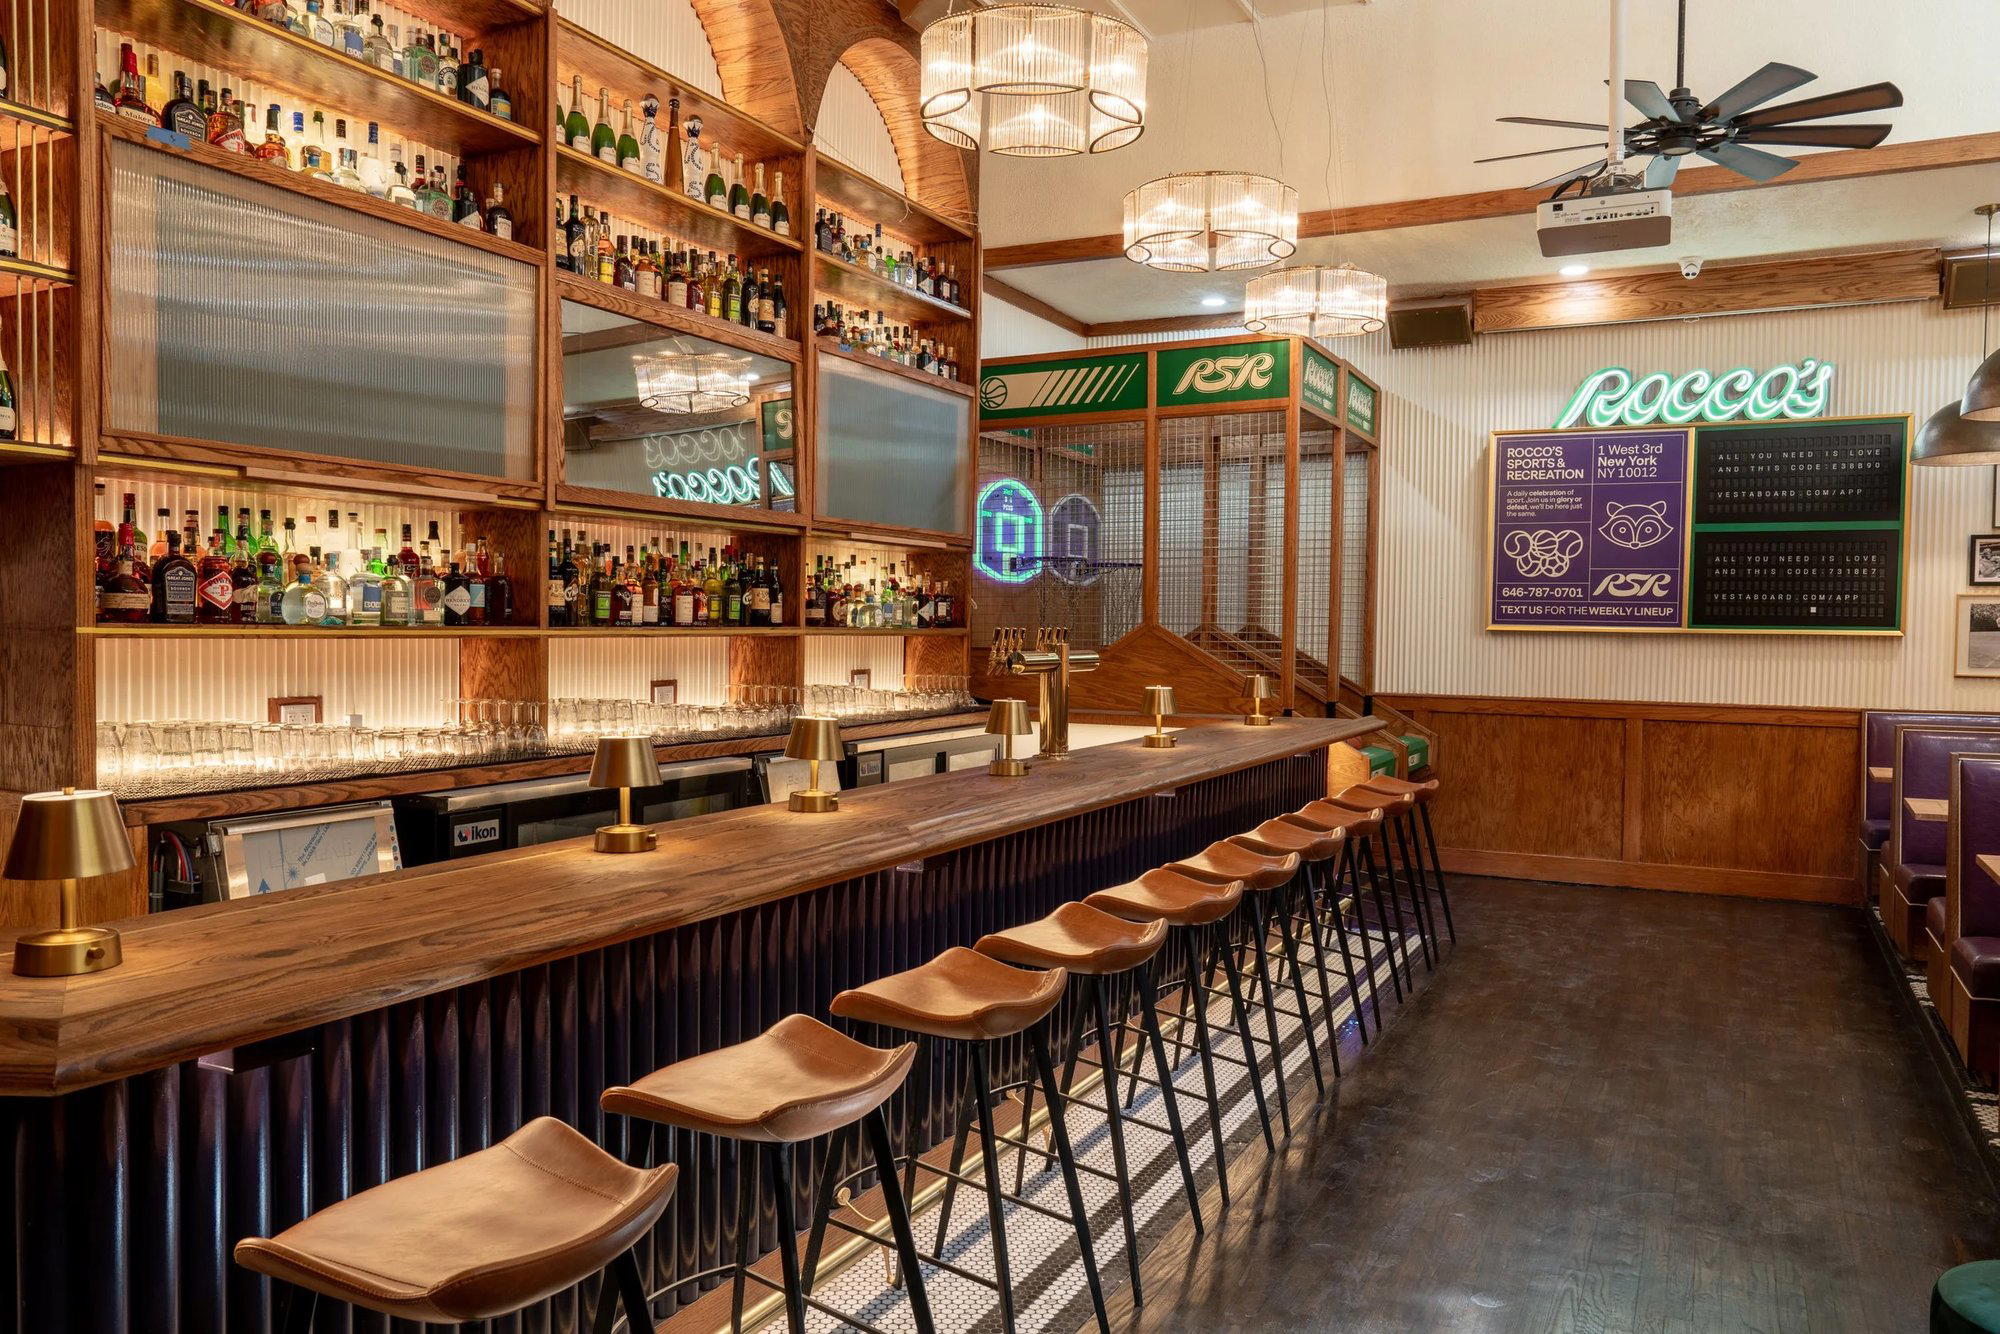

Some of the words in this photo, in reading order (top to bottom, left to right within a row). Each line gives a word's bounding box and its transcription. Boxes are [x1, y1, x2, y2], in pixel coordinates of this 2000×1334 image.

[95, 100, 113, 111] udson
[1507, 446, 1563, 458] ROCCO'S
[1598, 445, 1605, 456] 1
[1608, 444, 1640, 455] West
[1642, 443, 1663, 454] 3rd
[1750, 452, 1772, 460] YOU
[1782, 451, 1813, 459] NEED
[1849, 448, 1881, 457] LOVE
[1506, 458, 1555, 469] SPORTS
[1556, 458, 1566, 468] &
[1597, 456, 1626, 467] New
[1628, 455, 1658, 466] York
[1506, 468, 1584, 481] RECREATION
[1597, 467, 1616, 479] NY
[1618, 466, 1657, 478] 10012
[1718, 465, 1740, 473] AND
[1750, 464, 1780, 472] THIS
[1513, 490, 1529, 498] daily
[1529, 489, 1567, 497] celebration
[1556, 496, 1574, 504] glory
[1506, 503, 1530, 511] defeat,
[1569, 503, 1583, 511] just
[1502, 587, 1583, 598] 646-787-0701
[1501, 605, 1528, 615] TEXT
[1528, 605, 1543, 615] US
[1545, 606, 1566, 615] FOR
[1567, 606, 1588, 615] THE
[1589, 606, 1633, 616] WEEKLY
[1634, 607, 1674, 617] LINEUP
[471, 825, 497, 841] ikon
